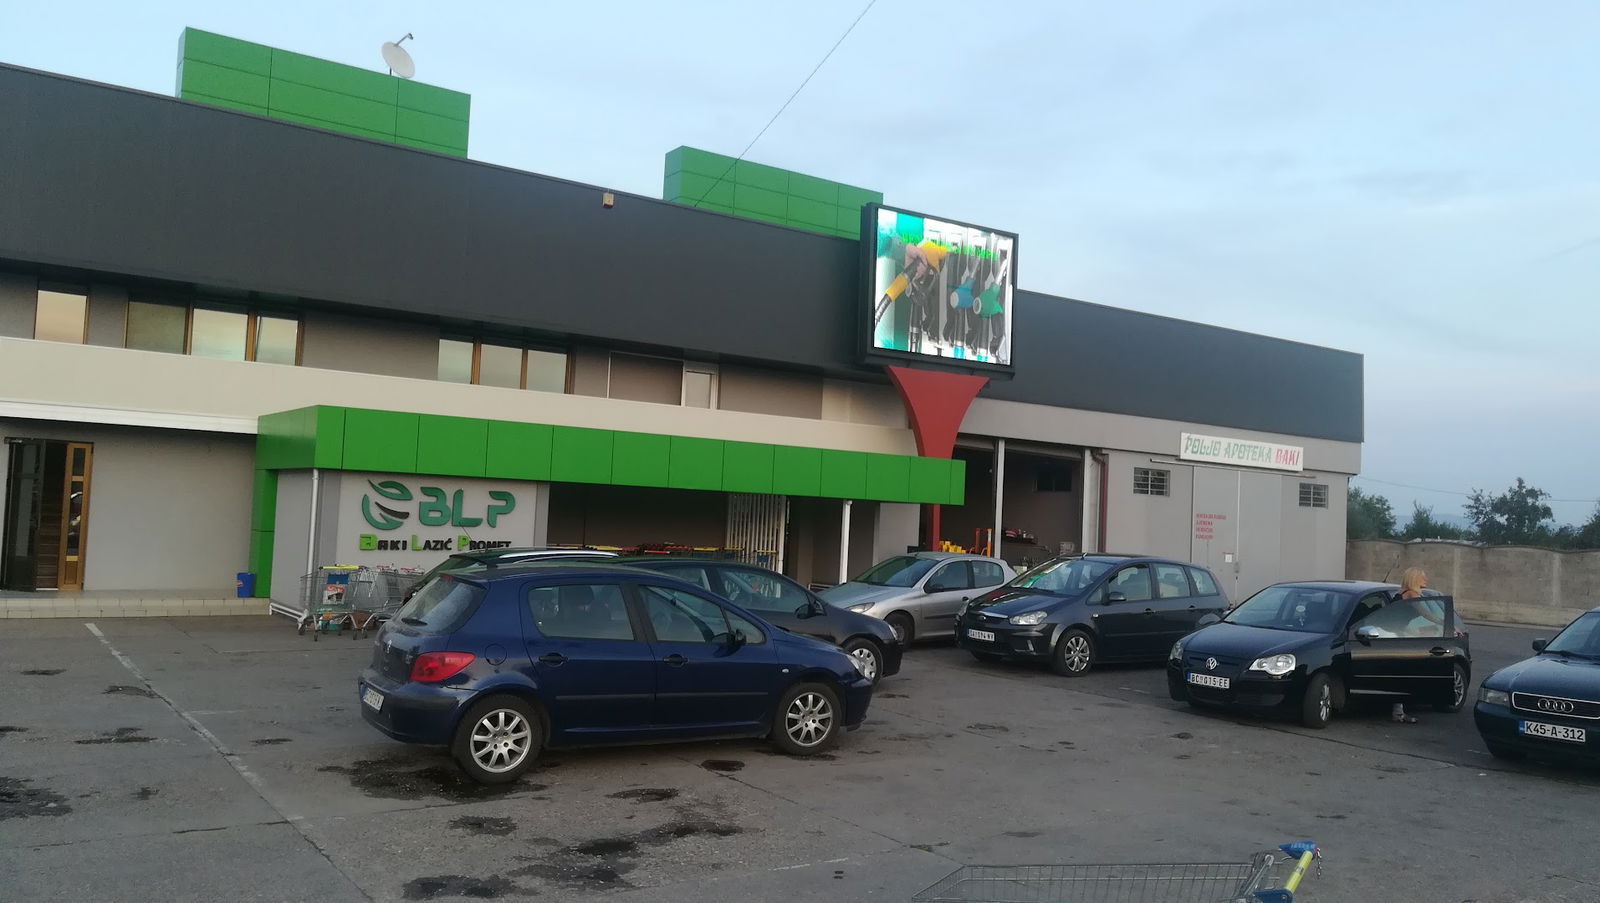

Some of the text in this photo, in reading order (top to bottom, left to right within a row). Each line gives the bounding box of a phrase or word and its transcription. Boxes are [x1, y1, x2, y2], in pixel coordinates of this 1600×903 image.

[1224, 441, 1272, 463] APOTEKA
[418, 486, 516, 528] BLP
[359, 533, 512, 551] BAKI LAZIĆ PROMET
[1525, 722, 1584, 741] K45-A-312
